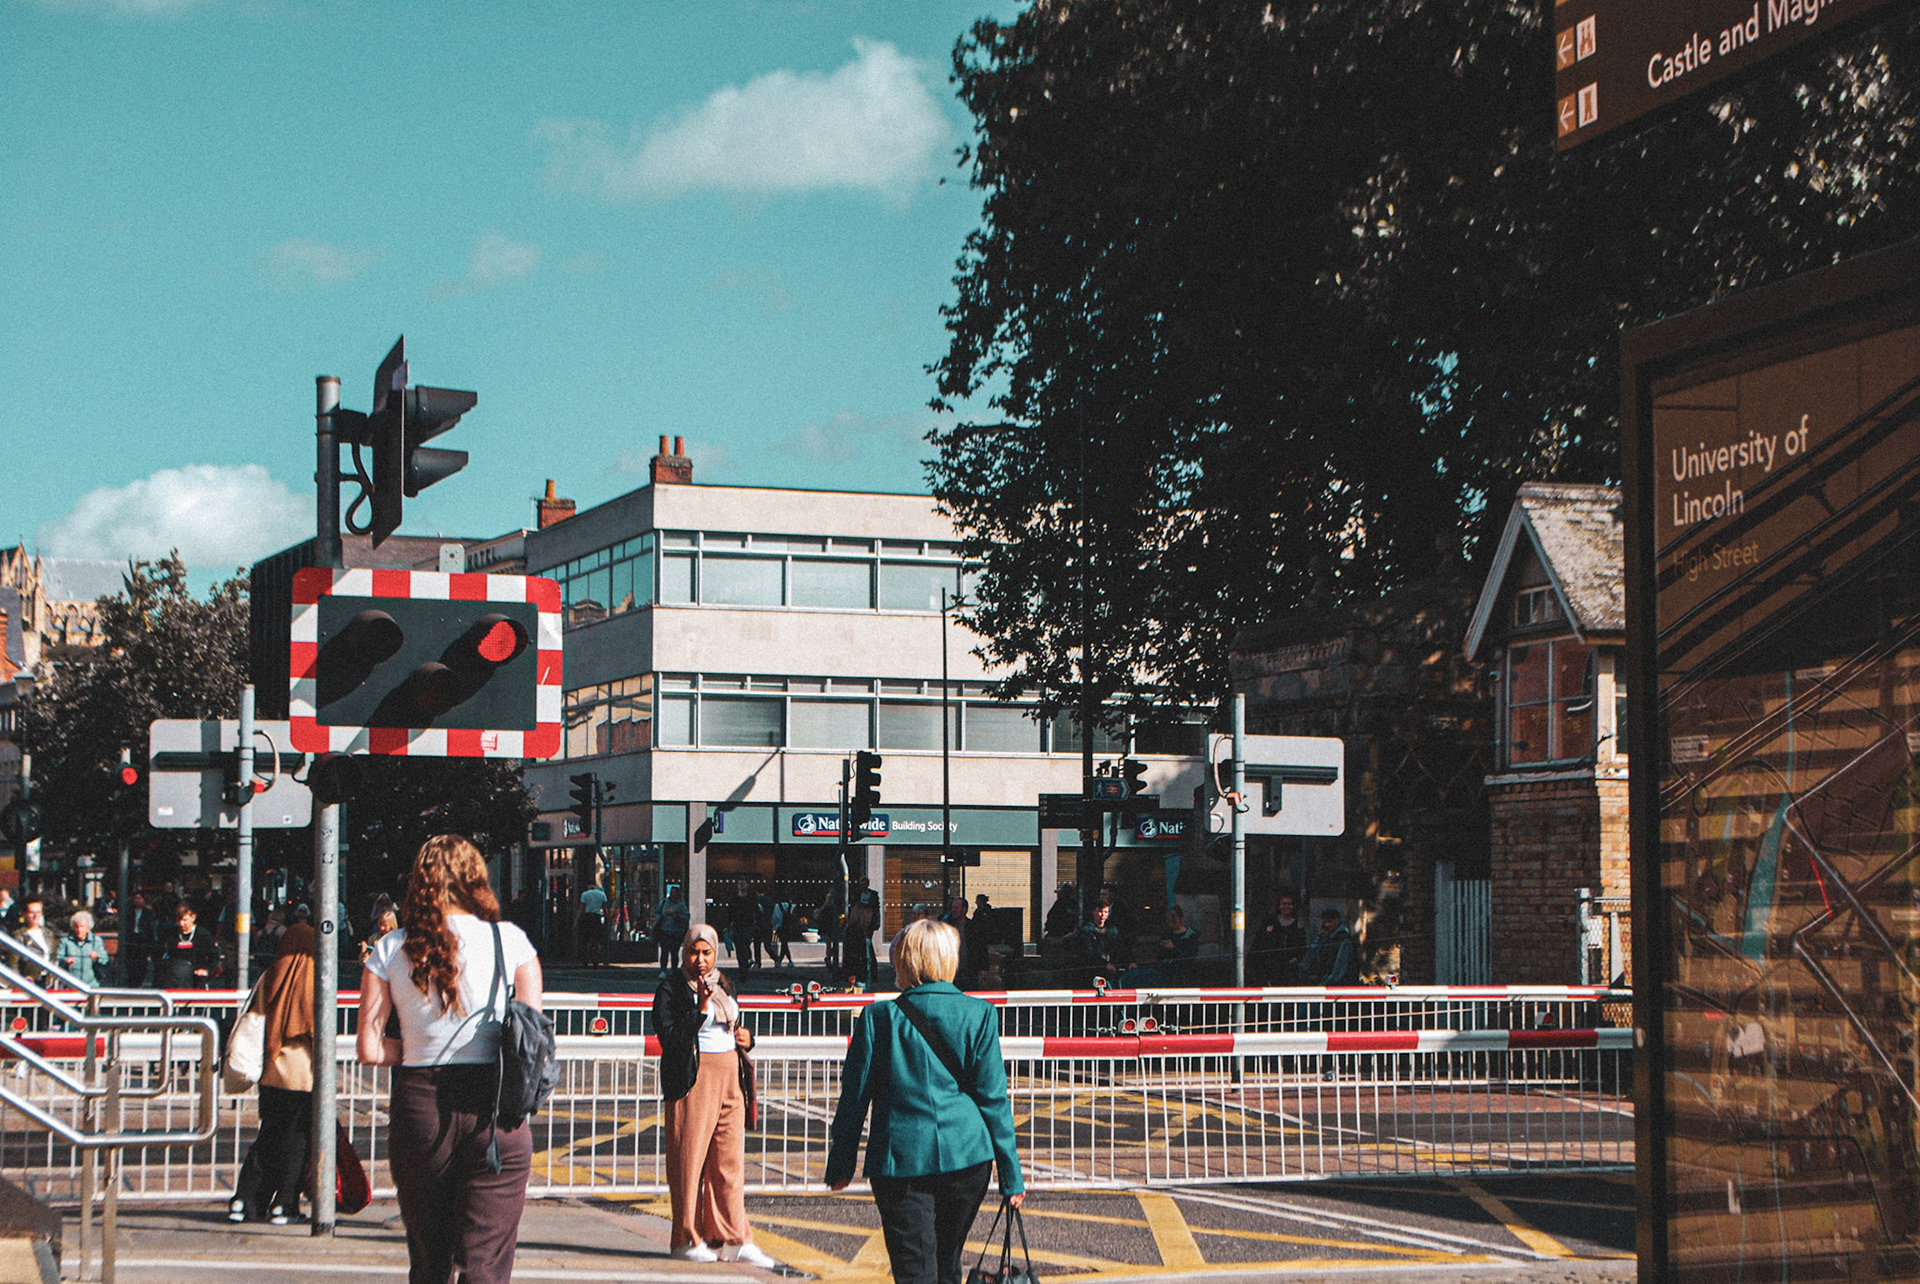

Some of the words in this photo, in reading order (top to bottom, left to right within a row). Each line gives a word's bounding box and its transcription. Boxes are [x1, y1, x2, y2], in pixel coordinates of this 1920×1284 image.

[1647, 32, 1712, 89] Castle
[1719, 1, 1760, 55] and
[1672, 430, 1777, 482] University
[1785, 413, 1809, 456] of
[1673, 479, 1745, 527] Lincoln
[1672, 546, 1709, 583] High
[1712, 540, 1760, 571] Street
[891, 820, 926, 833] Building
[927, 821, 958, 833] Socity
